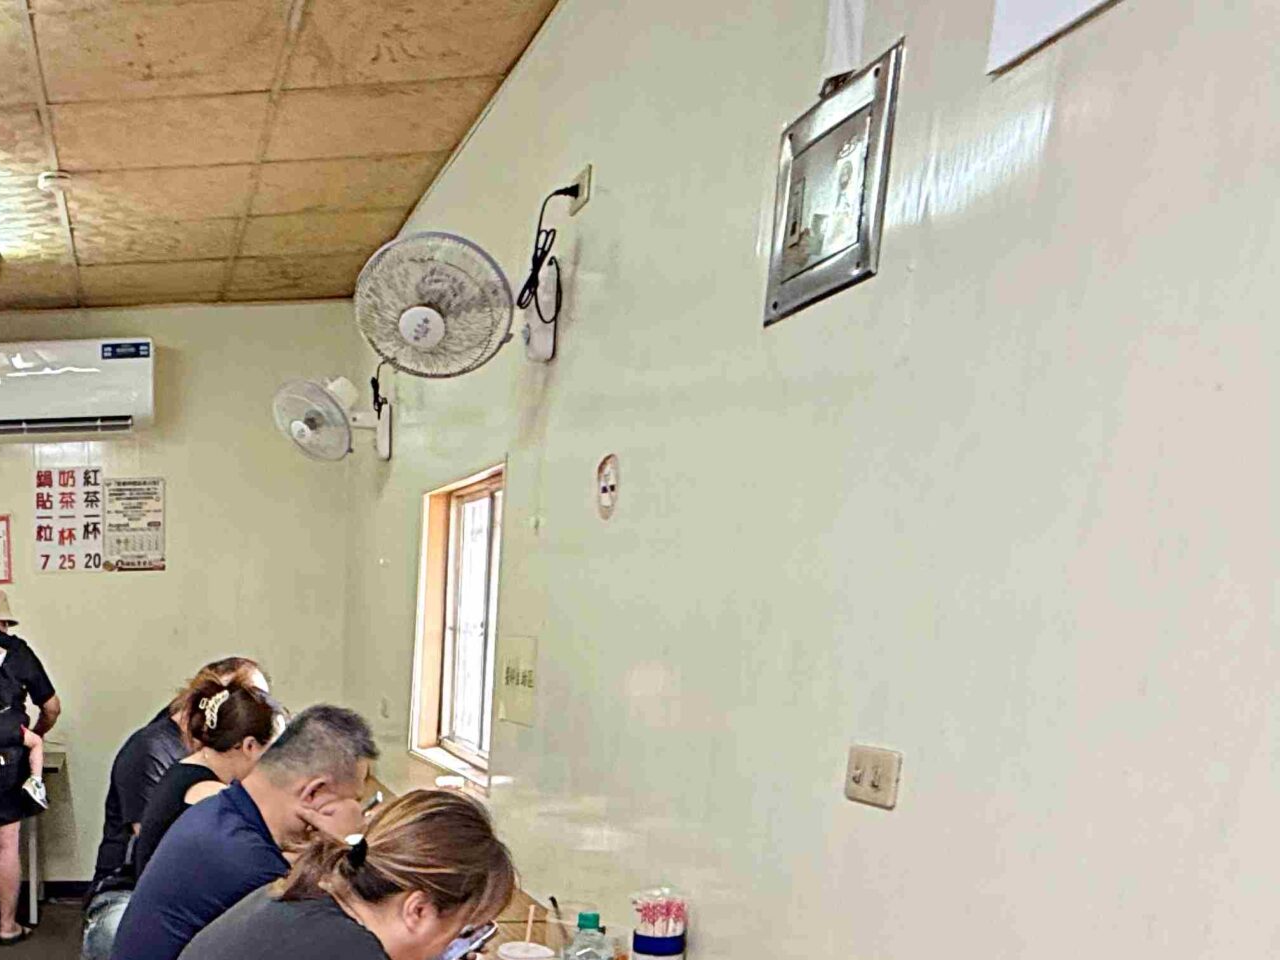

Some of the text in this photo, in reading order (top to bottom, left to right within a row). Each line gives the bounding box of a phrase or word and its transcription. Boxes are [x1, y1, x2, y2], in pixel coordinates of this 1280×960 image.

[36, 470, 53, 570] 鍋貼一粒 7
[58, 470, 77, 570] 奶茶一杯 25
[83, 469, 102, 569] 紅茶一杯 20
